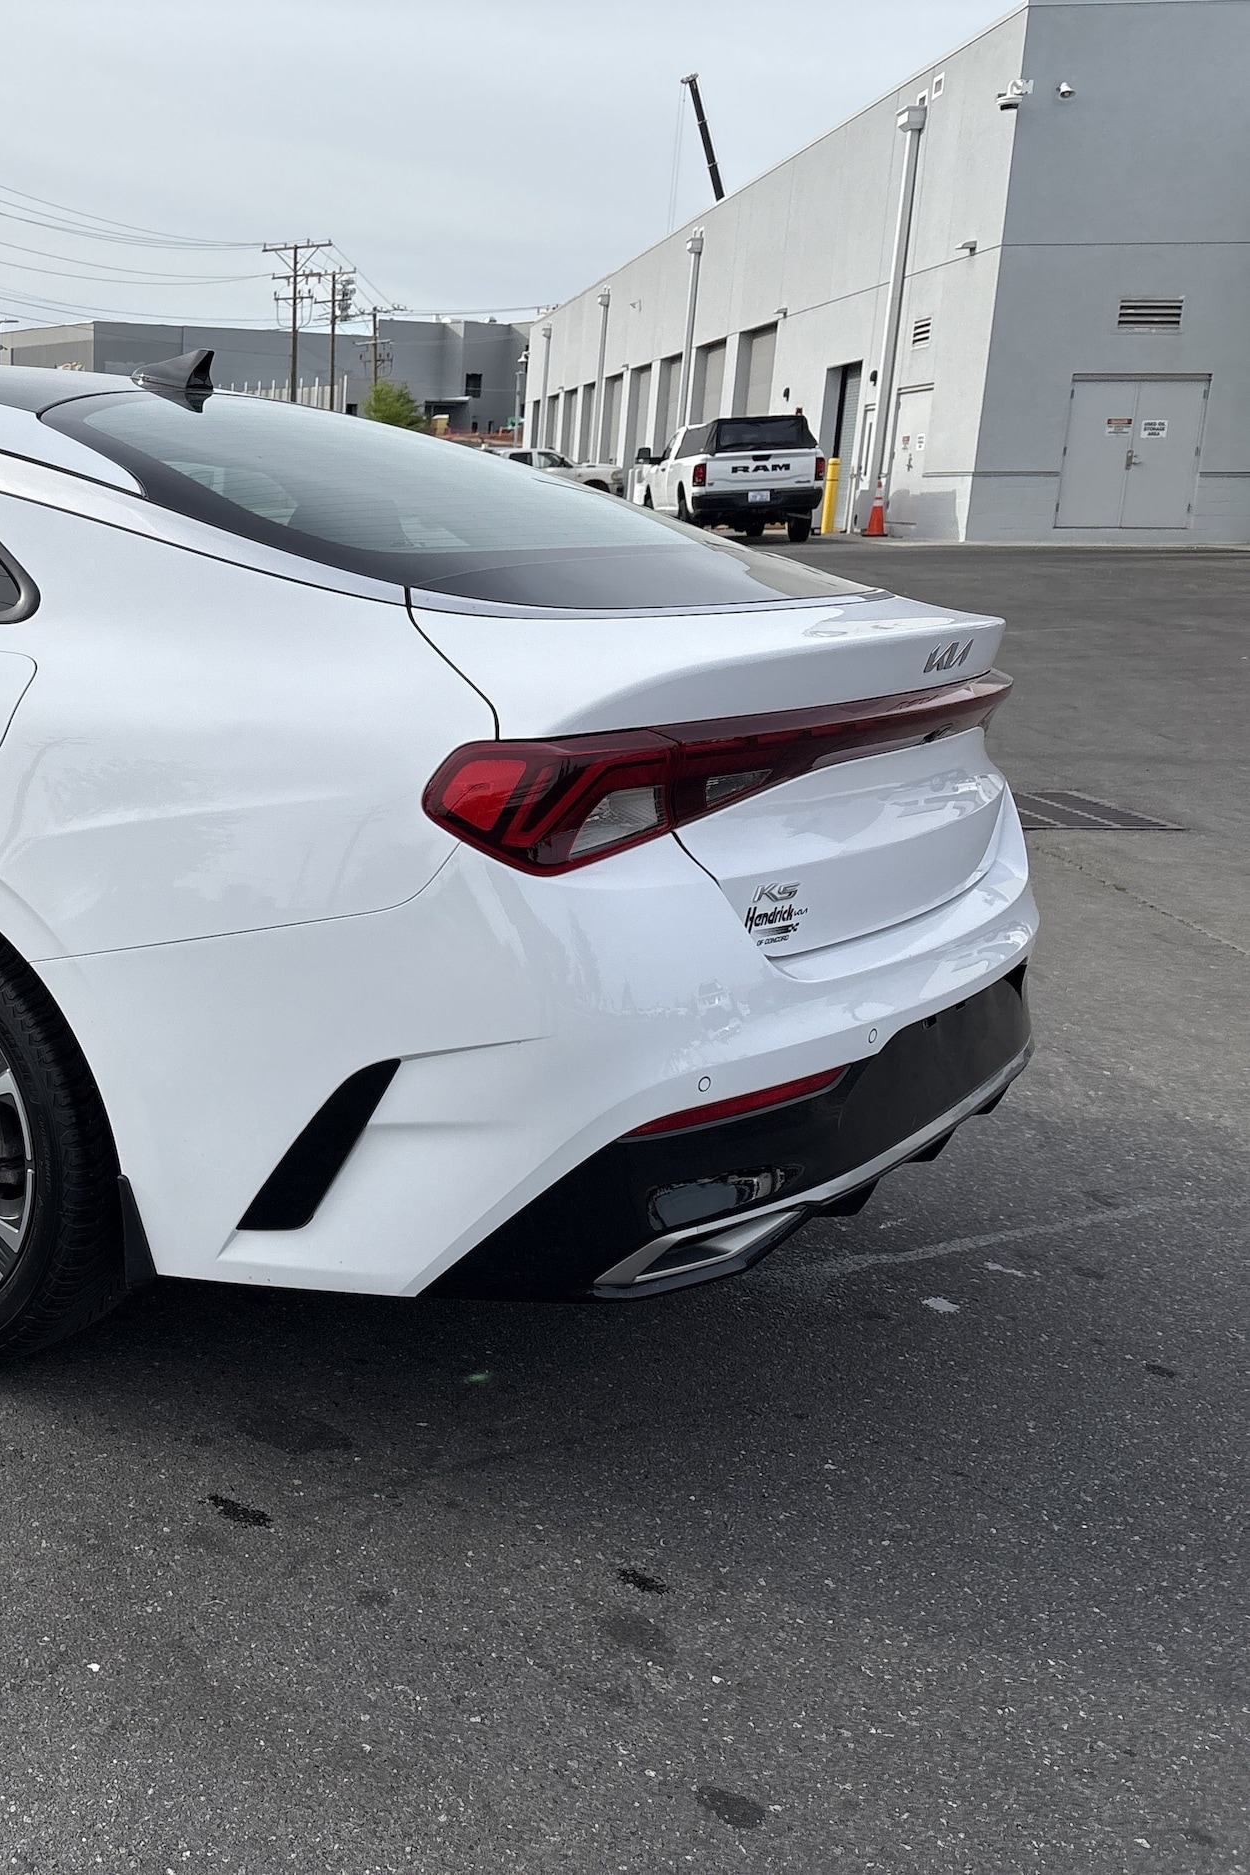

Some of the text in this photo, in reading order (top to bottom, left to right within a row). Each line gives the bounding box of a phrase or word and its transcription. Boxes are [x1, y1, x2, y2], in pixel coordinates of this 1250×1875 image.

[731, 463, 791, 474] RAM
[923, 638, 975, 673] KIA
[753, 881, 801, 903] K5
[745, 904, 794, 934] Hendrick
[765, 935, 790, 945] CONCORD
